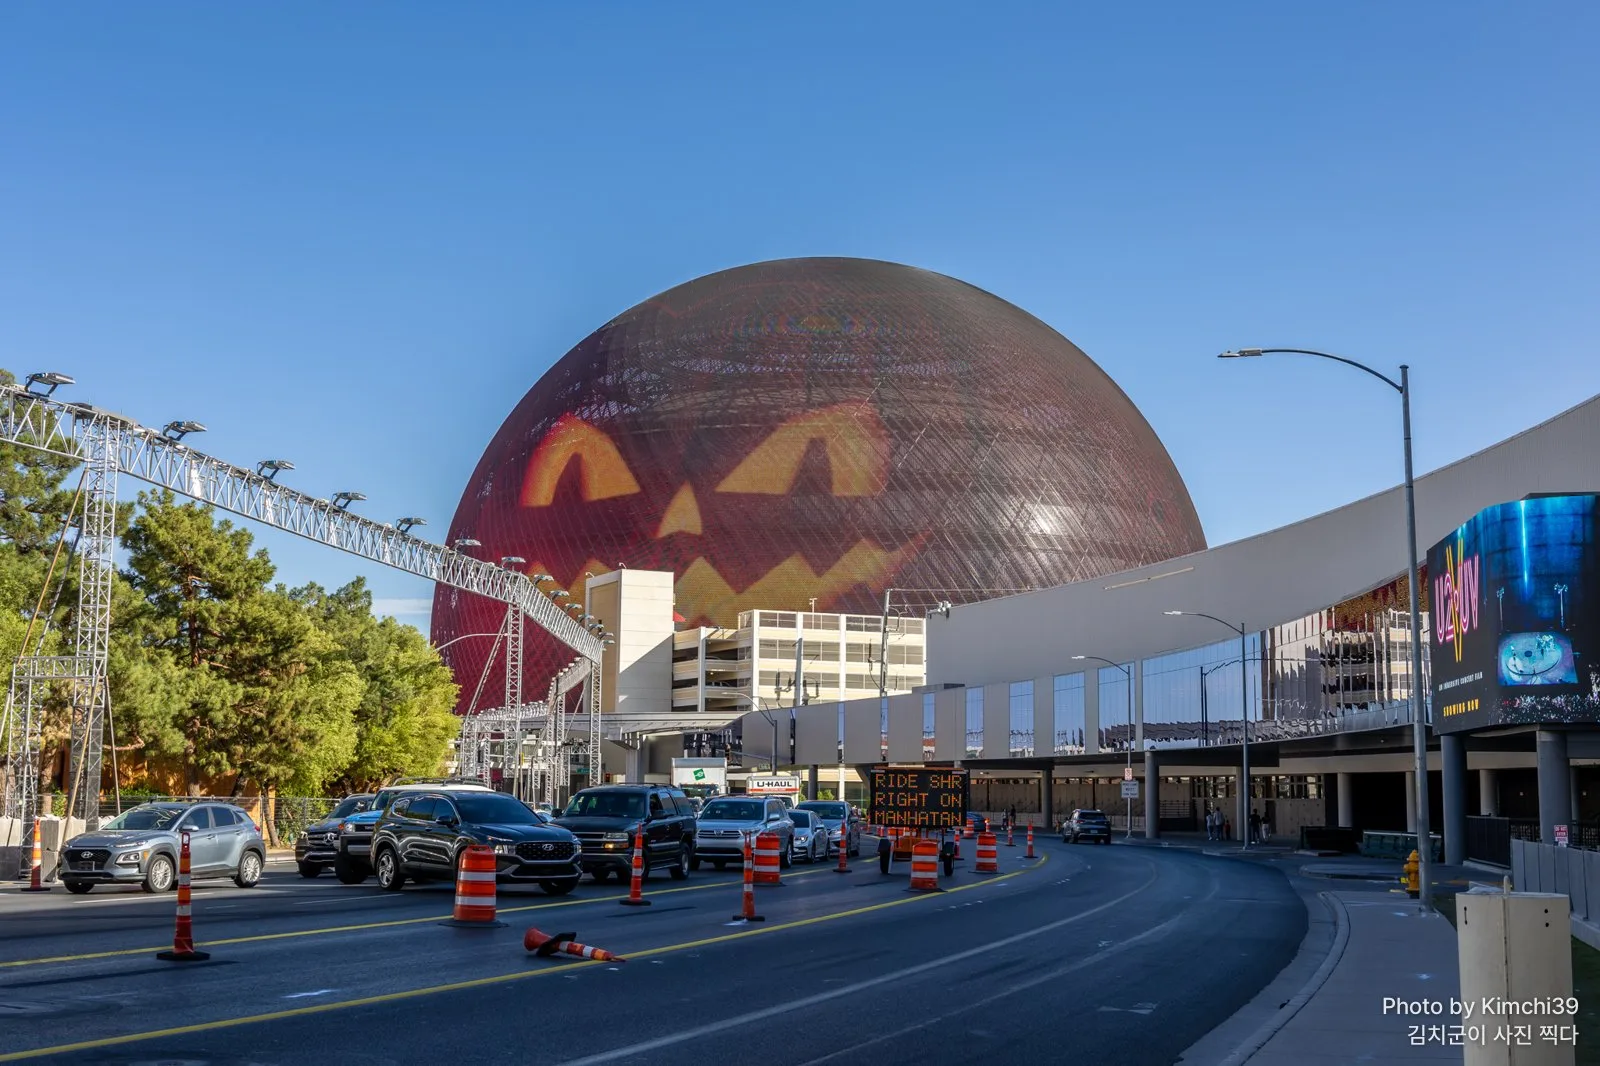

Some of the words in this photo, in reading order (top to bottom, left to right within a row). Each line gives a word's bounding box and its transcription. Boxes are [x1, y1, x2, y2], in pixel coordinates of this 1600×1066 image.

[1467, 698, 1479, 712] NOW
[875, 773, 918, 788] RIDE
[929, 774, 962, 789] SHR
[875, 792, 929, 807] RIGHT
[940, 793, 962, 808] ON
[875, 810, 962, 826] MANHATAN
